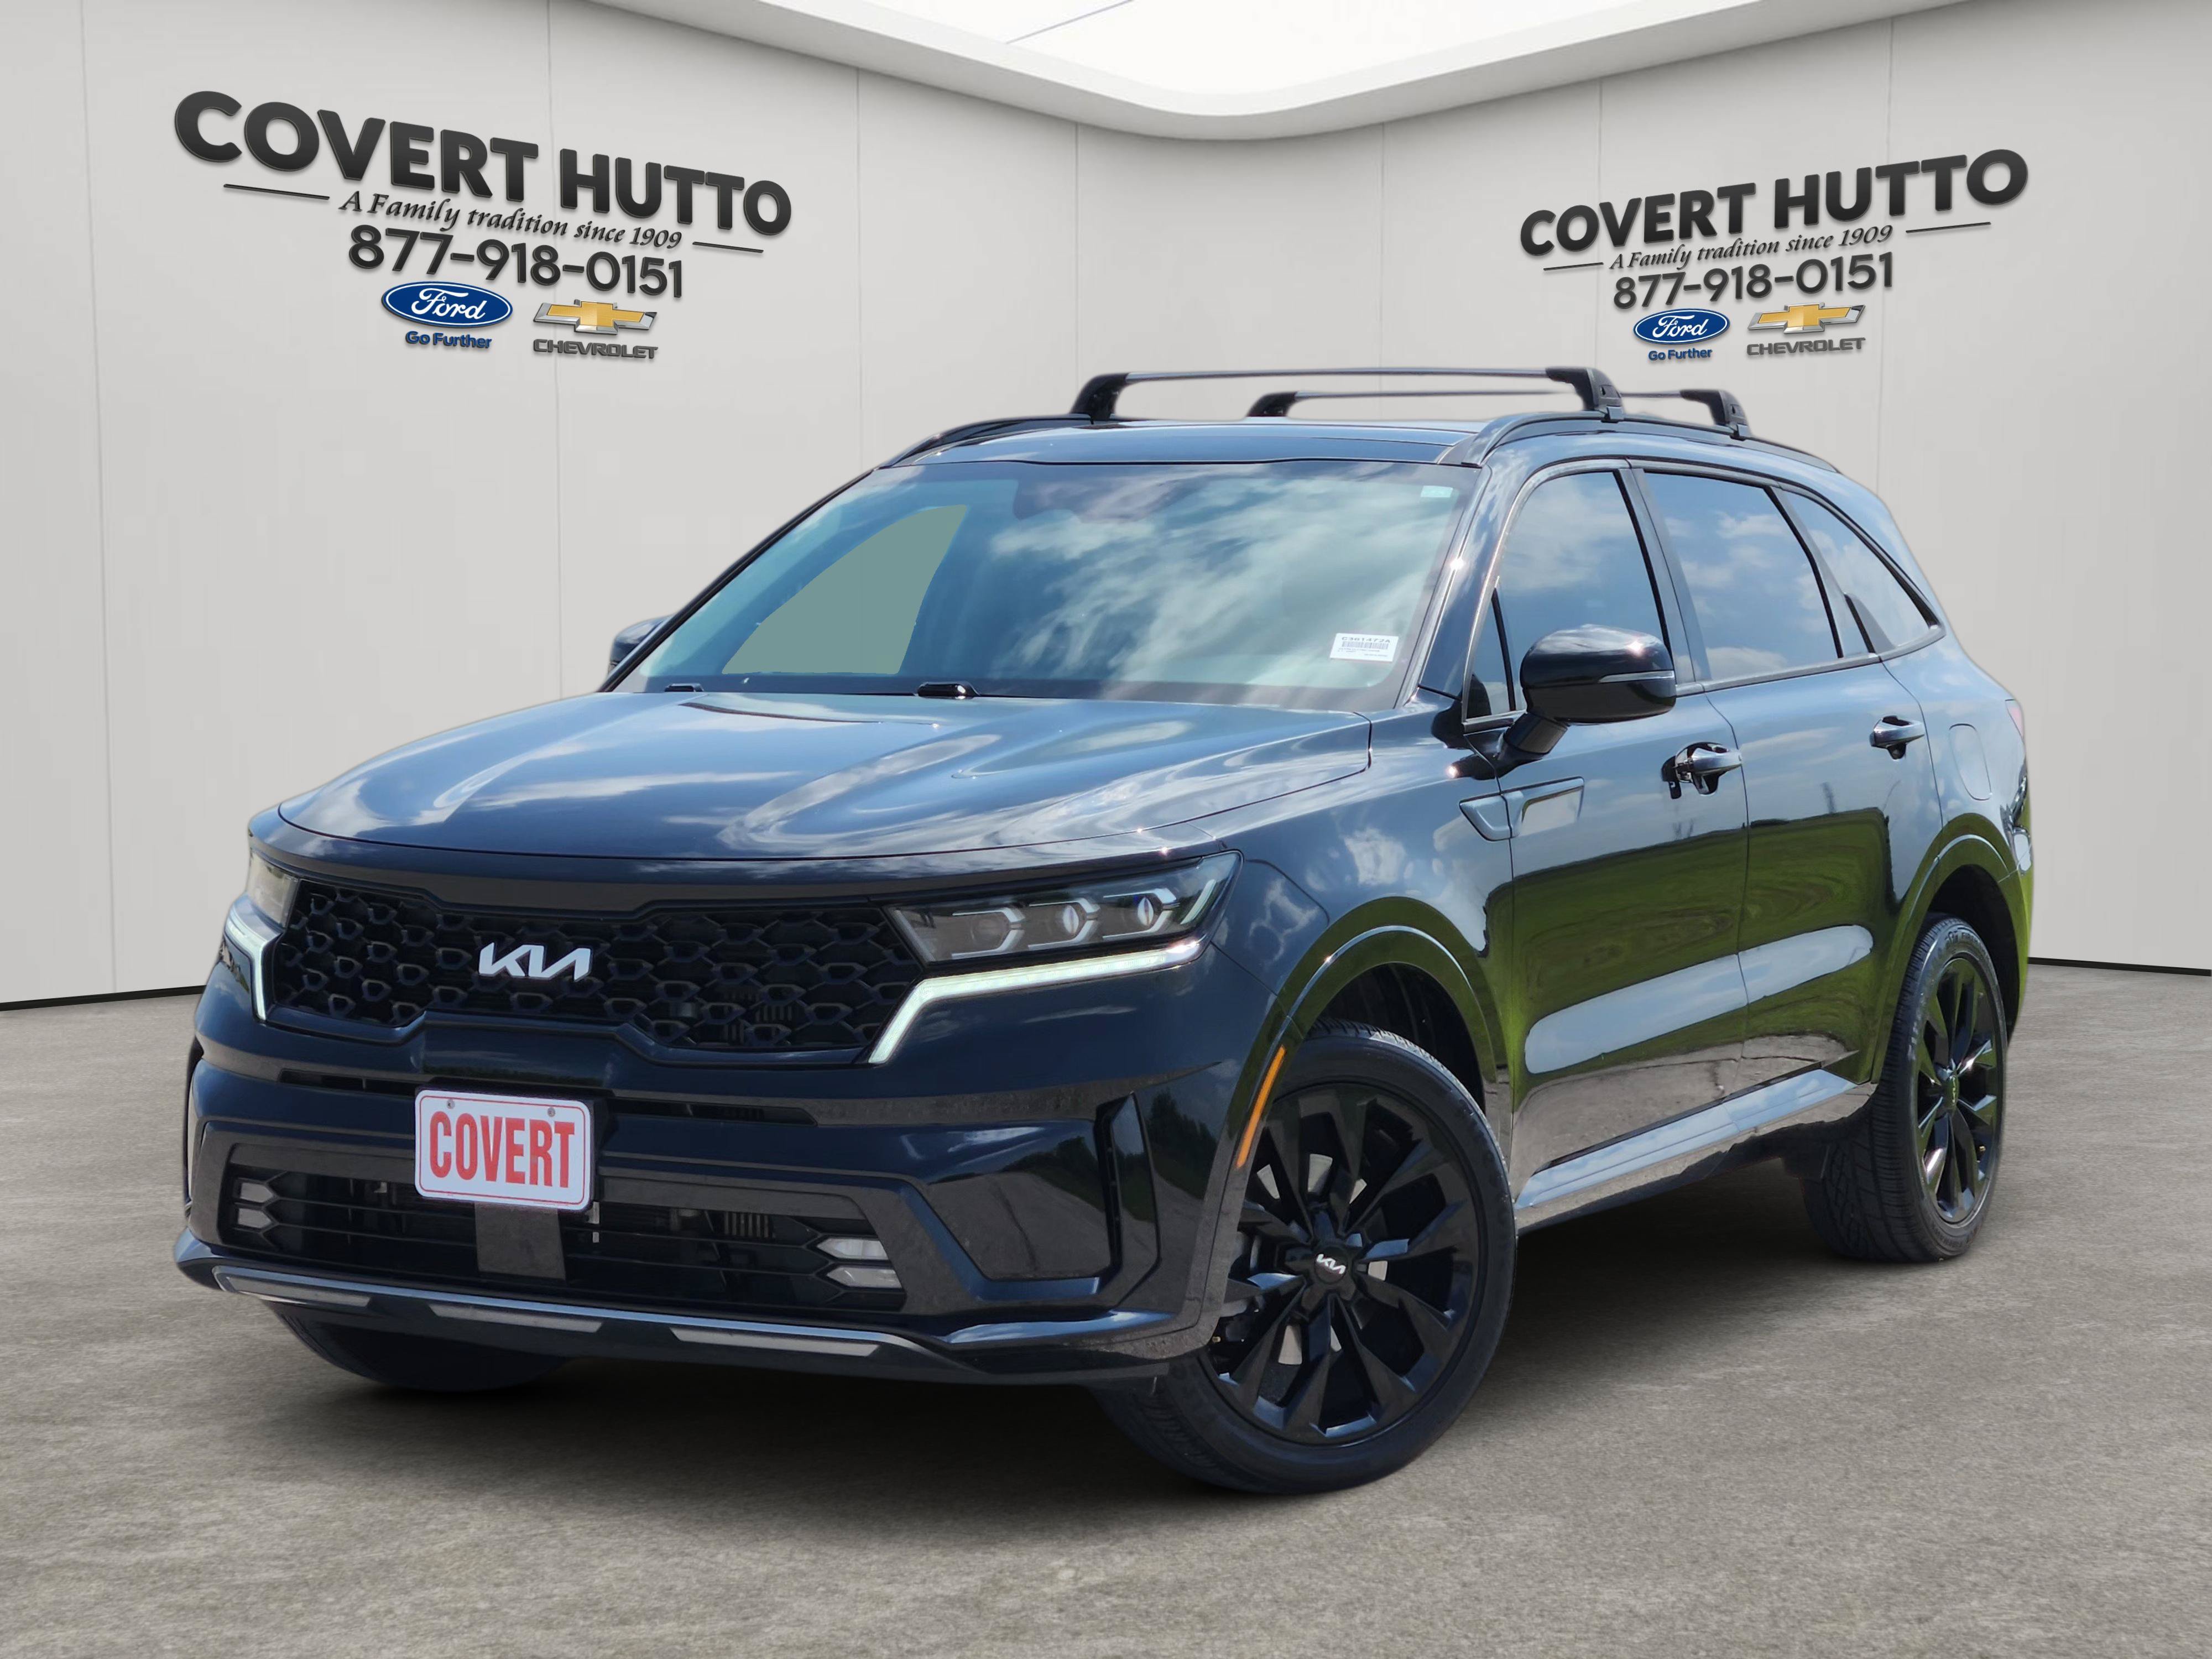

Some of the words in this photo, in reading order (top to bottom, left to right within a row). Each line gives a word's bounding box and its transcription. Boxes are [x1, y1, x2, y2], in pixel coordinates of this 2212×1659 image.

[175, 91, 539, 202] COVERT
[560, 148, 791, 236] HUTTO
[338, 190, 362, 211] A
[366, 194, 460, 231] Family
[467, 207, 567, 236] tradition
[573, 222, 625, 242] since
[630, 227, 682, 249] 1909
[1520, 182, 1756, 255] COVERT
[1774, 149, 2028, 228] HUTTO
[348, 225, 682, 298] 877-918-0151
[1610, 254, 1624, 269] A
[1627, 244, 1692, 269] Family
[1698, 238, 1779, 260] tradition
[1786, 232, 1834, 251] since
[1838, 225, 1893, 247] 1909
[1613, 252, 1893, 309] 877-918-0151
[411, 288, 486, 321] Ford
[1652, 315, 1707, 337] Ford
[405, 331, 430, 345] Go
[433, 332, 492, 348] Further
[534, 338, 659, 359] CHEVROLET
[1648, 351, 1666, 361] Go
[1668, 348, 1713, 359] Further
[1746, 337, 1866, 356] CHEVROLET
[430, 1110, 575, 1188] COVERT
